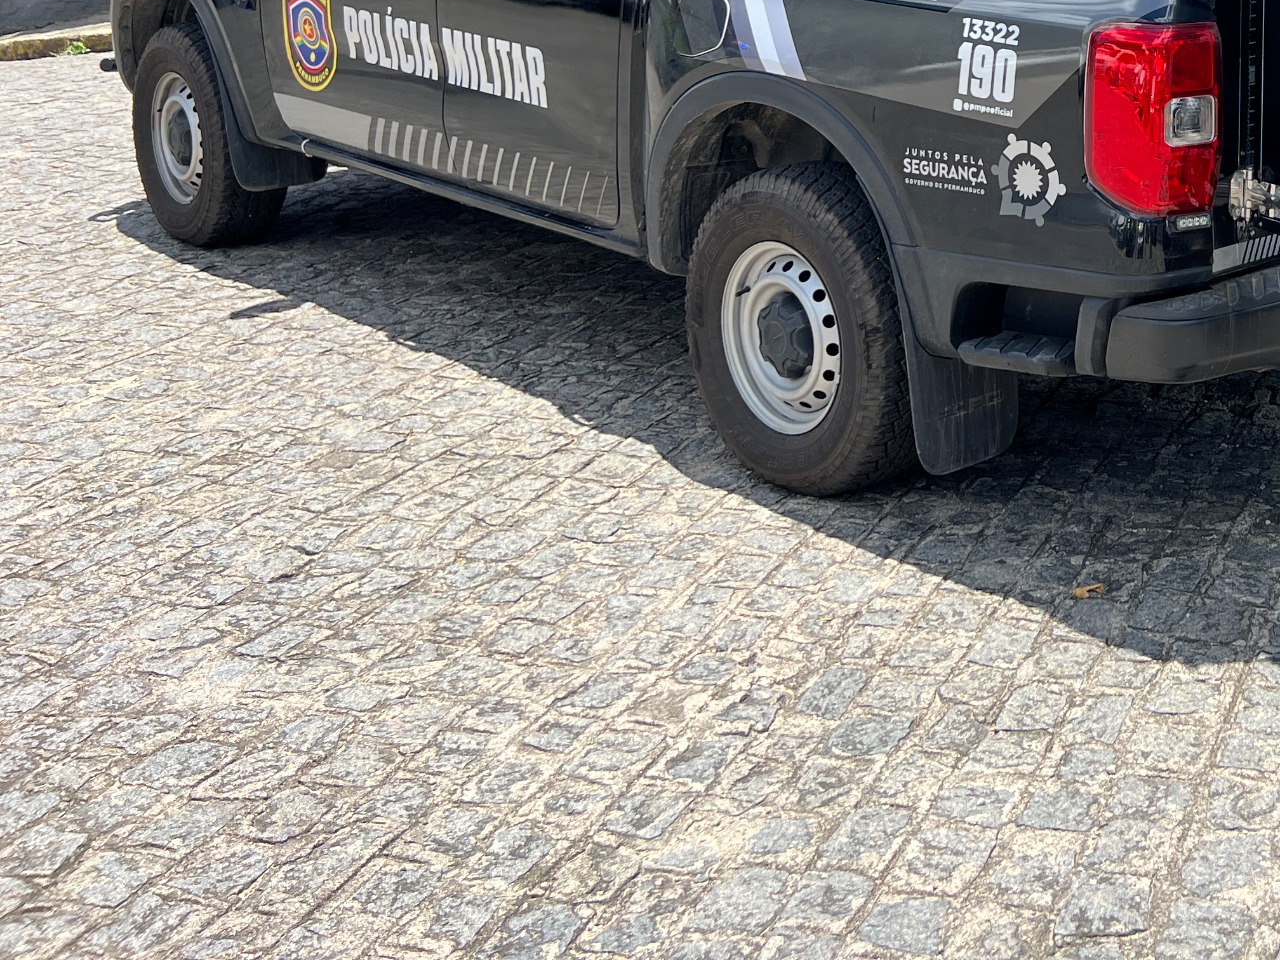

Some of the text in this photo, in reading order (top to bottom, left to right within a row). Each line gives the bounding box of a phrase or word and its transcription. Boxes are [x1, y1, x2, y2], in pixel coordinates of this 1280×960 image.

[962, 17, 1020, 46] 13322
[342, 6, 549, 109] POLÍCIA MILITAR
[957, 41, 1018, 103] 190
[295, 61, 330, 84] PERNAMBUCO
[905, 147, 984, 166] JUNTOS PELA
[903, 157, 988, 186] SEGURANÇA
[904, 177, 934, 188] GOVERNO
[943, 183, 986, 195] PERNAMBUCO
